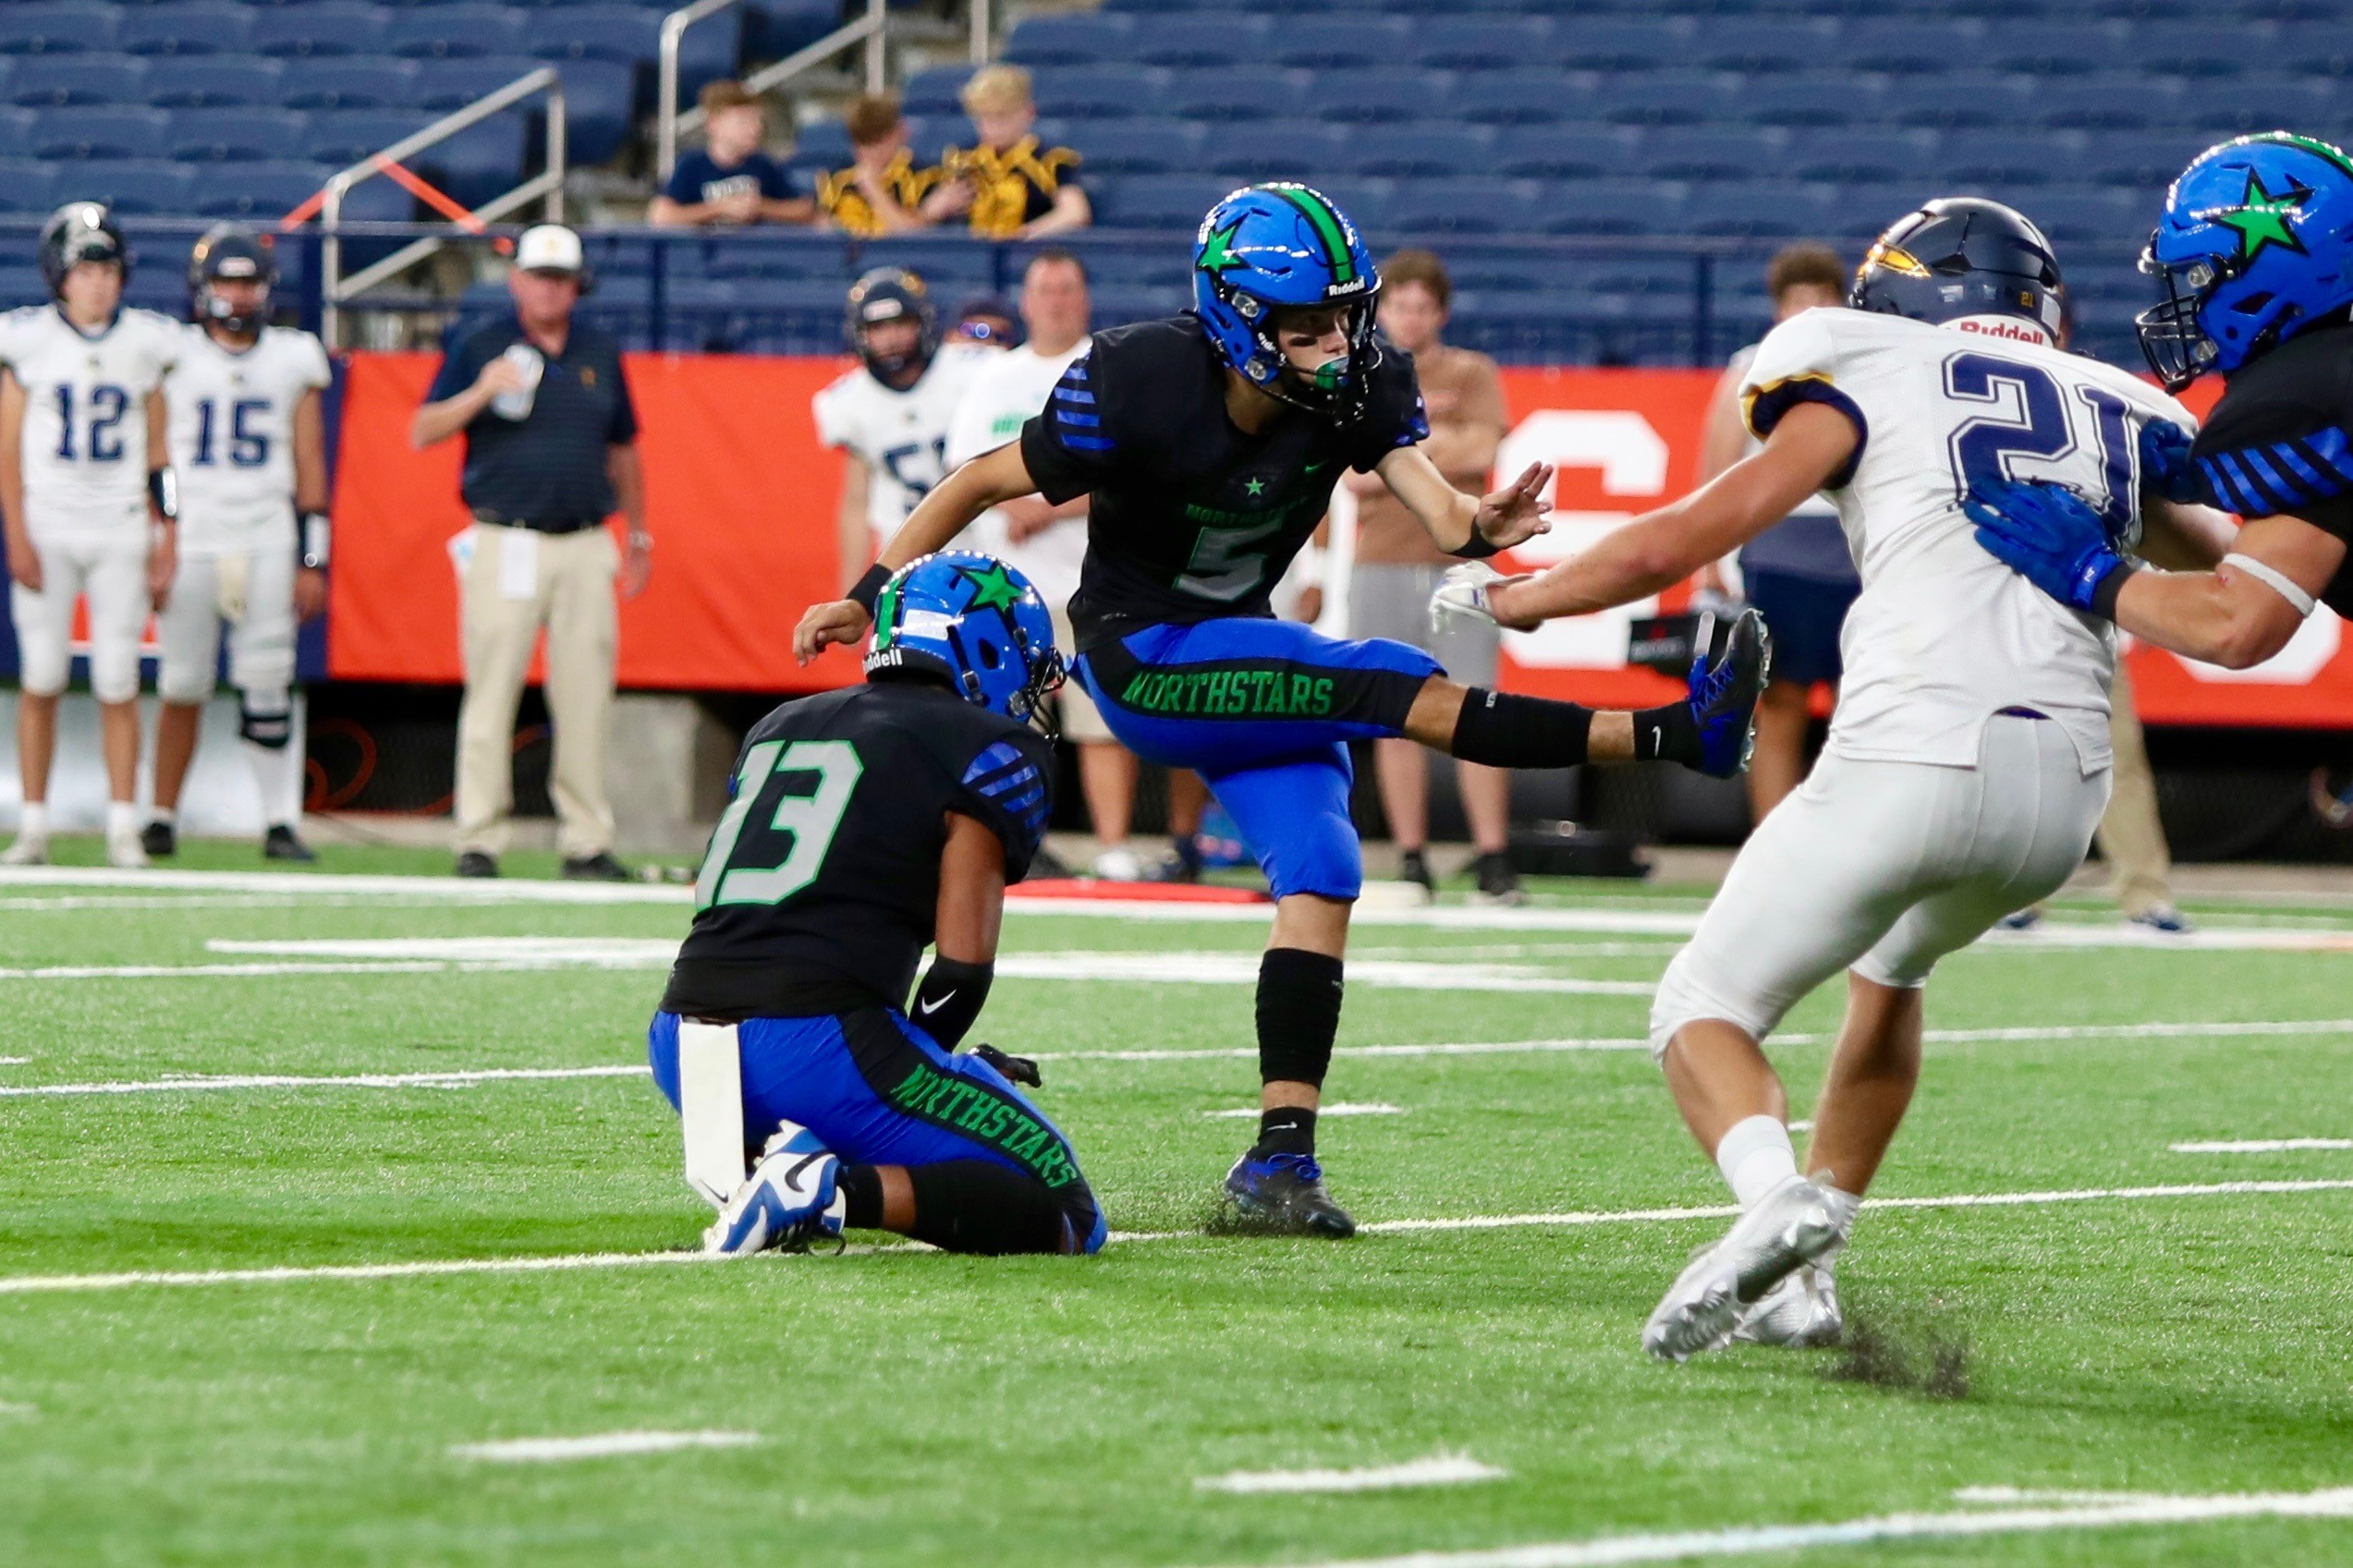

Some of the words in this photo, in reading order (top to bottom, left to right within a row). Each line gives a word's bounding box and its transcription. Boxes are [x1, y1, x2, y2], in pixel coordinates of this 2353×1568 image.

[1960, 321, 2043, 345] Riddell
[55, 384, 128, 462] 12
[192, 398, 271, 467] 15
[1942, 349, 2139, 552] 21
[883, 432, 947, 519] 5
[1171, 524, 1287, 602] 5
[1121, 671, 1334, 715] NORTHSTARS
[695, 739, 865, 913] 13
